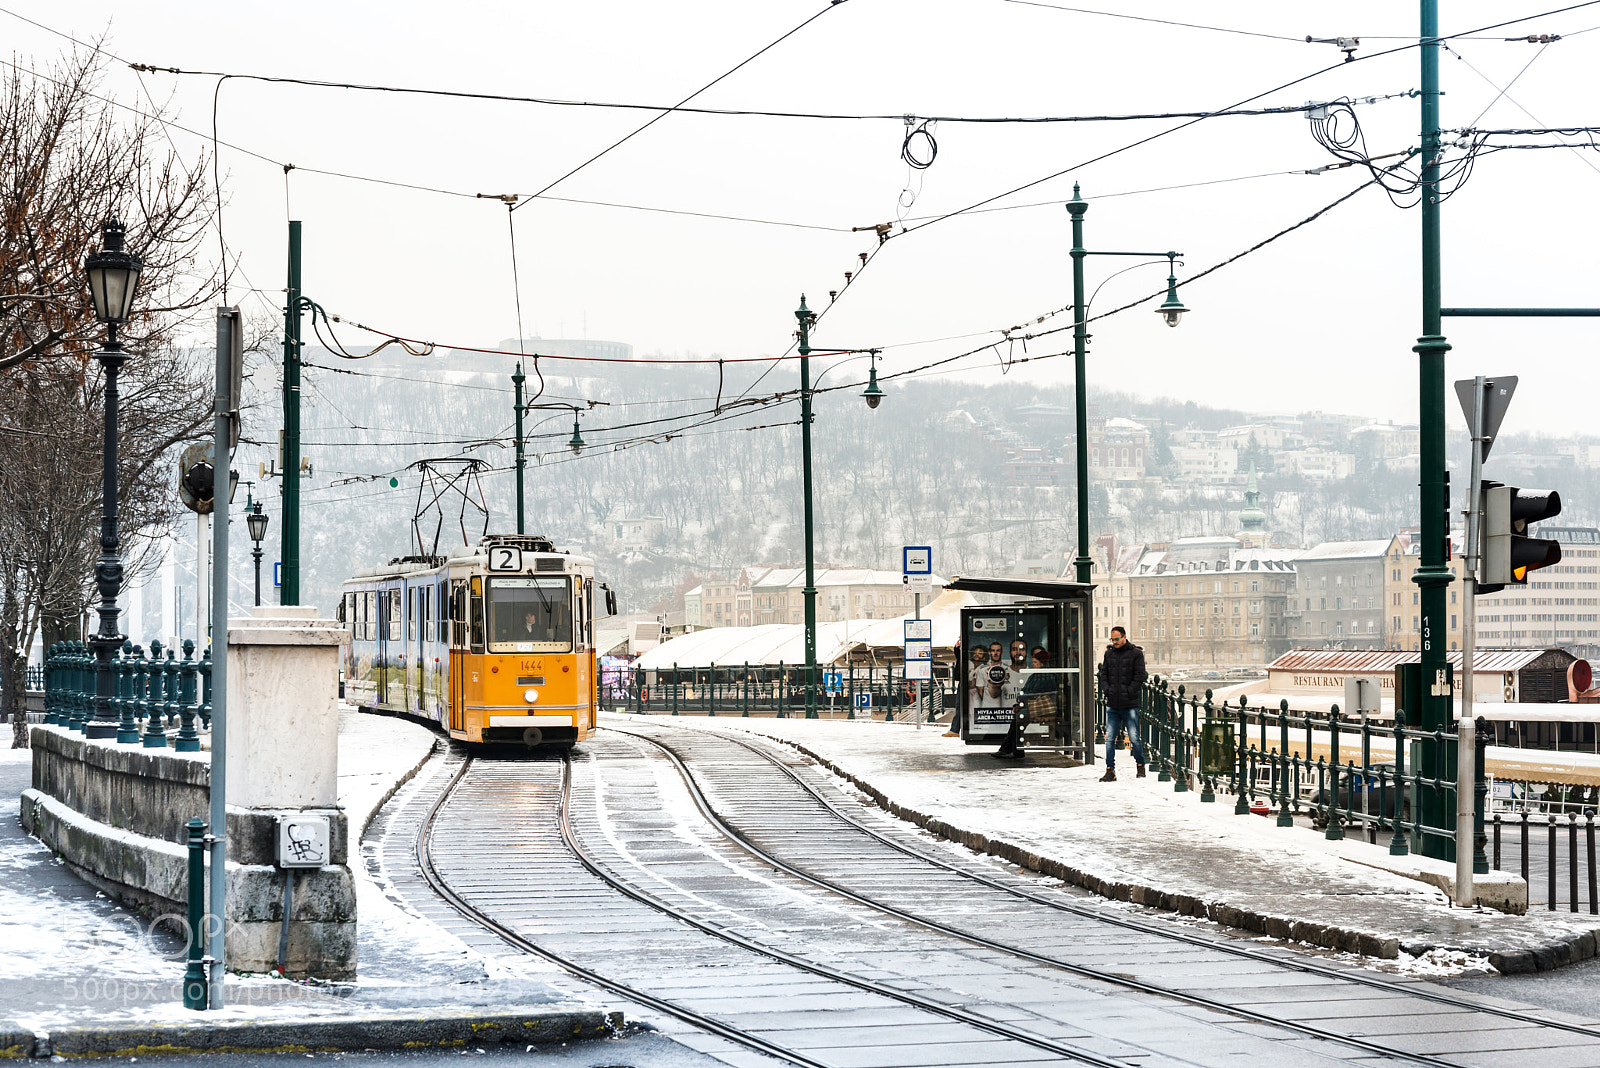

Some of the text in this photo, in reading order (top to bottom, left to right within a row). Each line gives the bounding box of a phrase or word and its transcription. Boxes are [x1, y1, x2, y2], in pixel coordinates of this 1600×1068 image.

[499, 550, 513, 569] 2
[1423, 616, 1431, 651] 136
[521, 660, 542, 671] 1444
[1294, 676, 1345, 687] RESTAURANT
